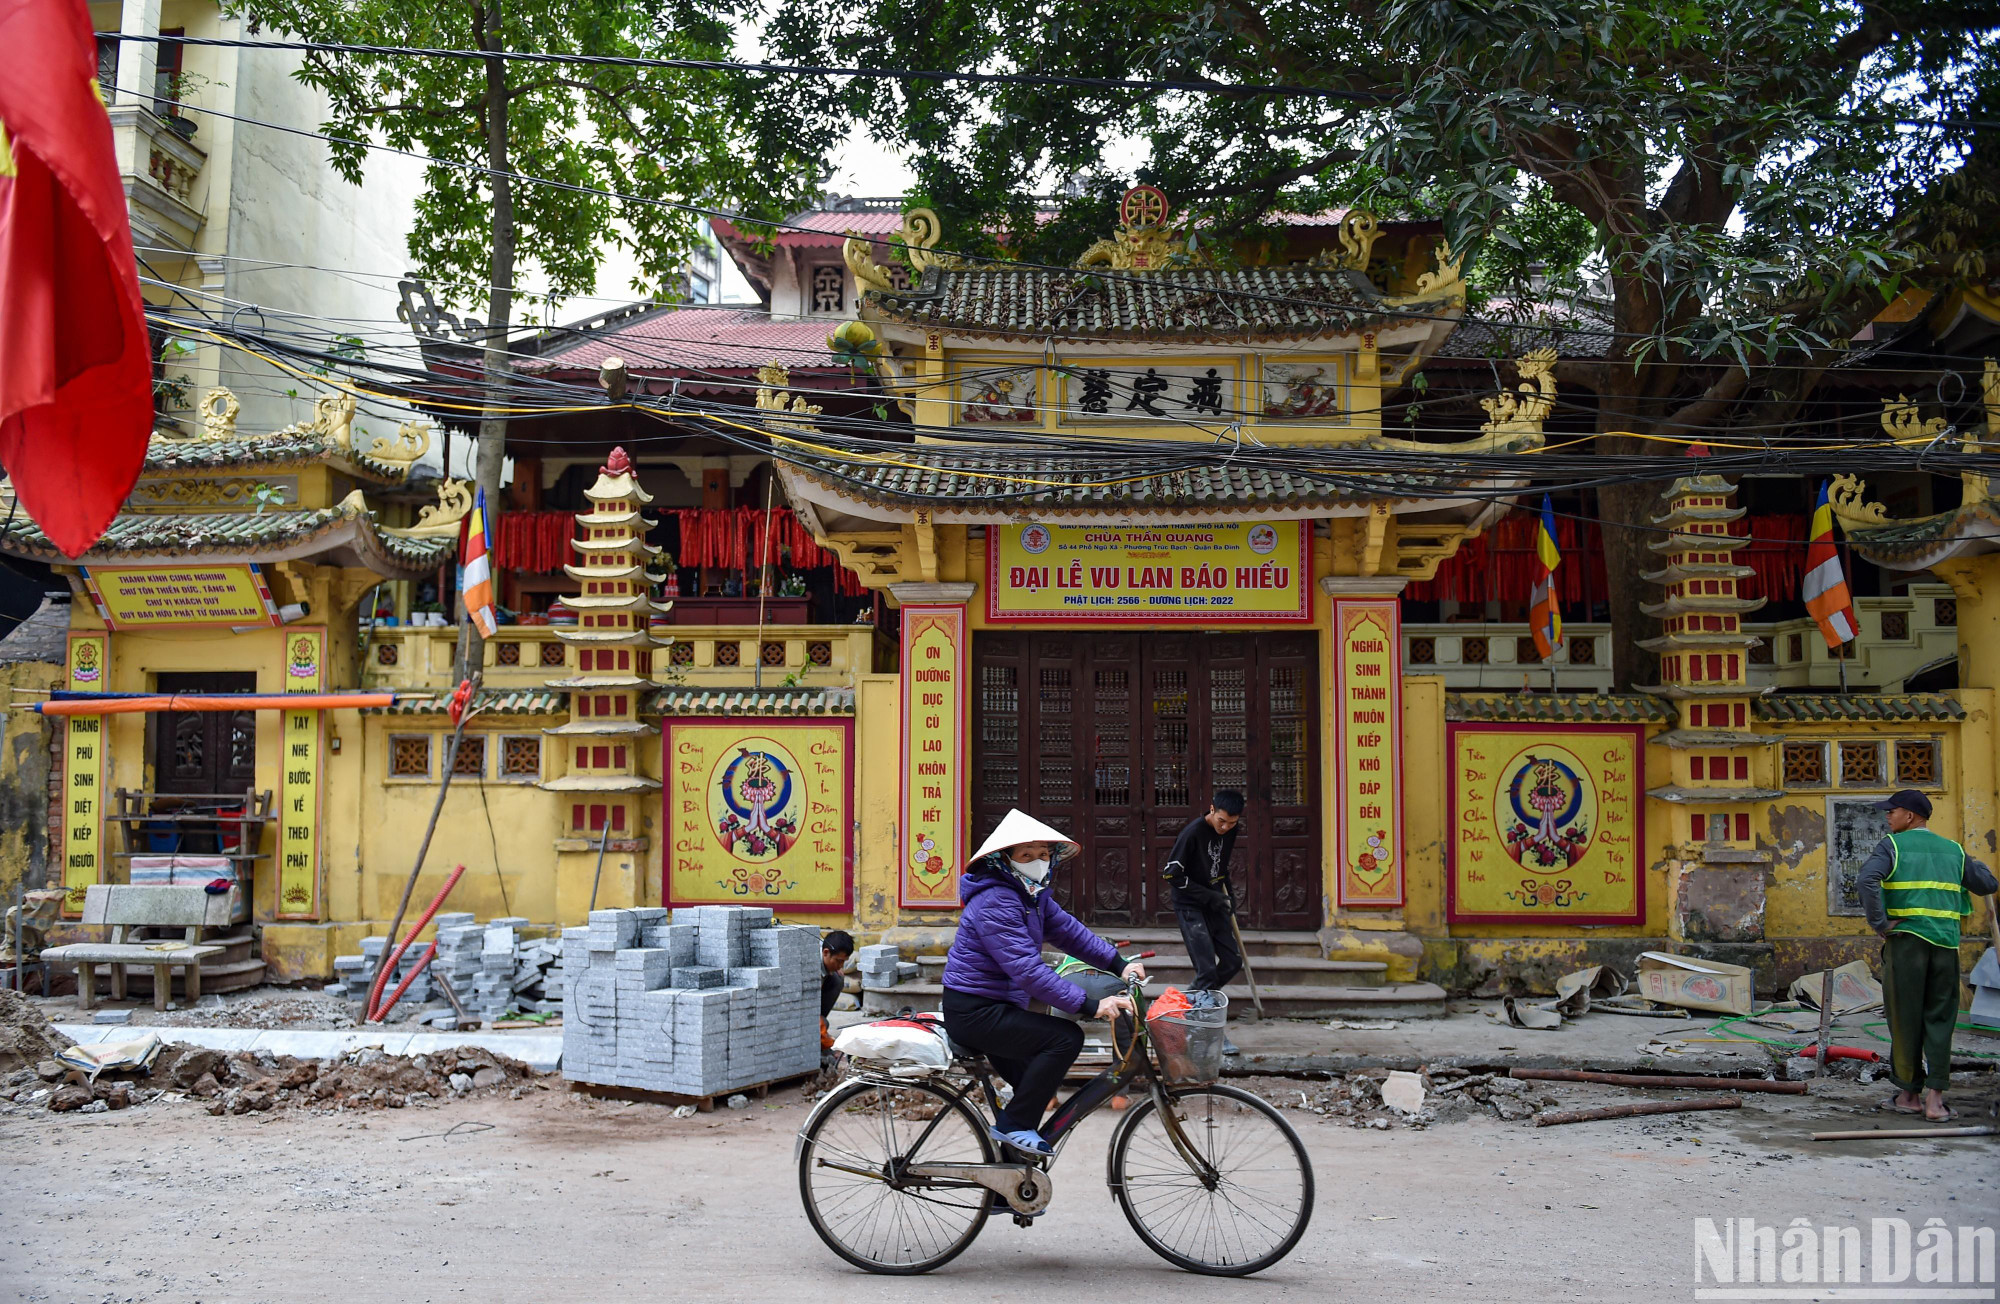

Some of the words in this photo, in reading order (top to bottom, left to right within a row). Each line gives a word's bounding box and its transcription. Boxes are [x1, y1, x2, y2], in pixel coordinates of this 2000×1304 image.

[1084, 531, 1121, 542] CHÙA
[1165, 533, 1214, 543] QUANG
[118, 575, 146, 584] THÀNH
[147, 574, 168, 583] KÍNH
[194, 573, 226, 581] NGHINH
[1010, 568, 1048, 592] ĐẠI
[1057, 559, 1082, 588] LỄ
[1091, 568, 1121, 588] VU
[1128, 568, 1172, 588] LAN
[1181, 562, 1228, 588] BÁO
[1236, 560, 1289, 588] HIẾU
[120, 588, 137, 596] CHƯ
[145, 598, 162, 606] CHƯ
[164, 599, 173, 608] VỊ
[174, 597, 201, 606] KHÁCH
[1064, 595, 1088, 606] PHẬT
[1091, 596, 1114, 606] LỊCH:
[1117, 596, 1140, 605] 2566
[1149, 595, 1181, 605] DƯƠNG
[1184, 596, 1208, 606] LỊCH:
[1211, 596, 1233, 605] 2022
[174, 610, 195, 619] PHẬT
[209, 608, 237, 617] QUANG
[239, 607, 258, 616] LÂM
[926, 646, 940, 659] ƠN
[1352, 638, 1384, 653] NGHĨA
[916, 667, 950, 682] DƯỠNG
[1356, 664, 1380, 676] SINH
[923, 693, 943, 708] DỤC
[1352, 686, 1386, 700] THÀNH
[294, 716, 309, 730] TAY
[926, 713, 940, 729] CÙ
[1354, 708, 1384, 724] MUÔN
[72, 717, 98, 733] THÁNG
[923, 740, 942, 752] LAO
[1357, 731, 1381, 747] KIẾP
[76, 745, 93, 760] PHÙ
[292, 745, 309, 761] NHẸ
[815, 762, 835, 775] Tâm
[918, 760, 946, 775] KHÔN
[1359, 756, 1380, 771] KHÓ
[74, 774, 93, 787] SINH
[289, 770, 311, 784] BƯỚC
[922, 782, 941, 799] TRẢ
[1359, 779, 1380, 795] ĐÁP
[75, 799, 92, 816] DIỆT
[923, 806, 941, 822] HẾT
[74, 823, 92, 840] KIẾP
[288, 827, 309, 840] THEO
[70, 853, 94, 868] NGƯỜI
[287, 854, 309, 871] PHẬT
[815, 861, 833, 872] Môn
